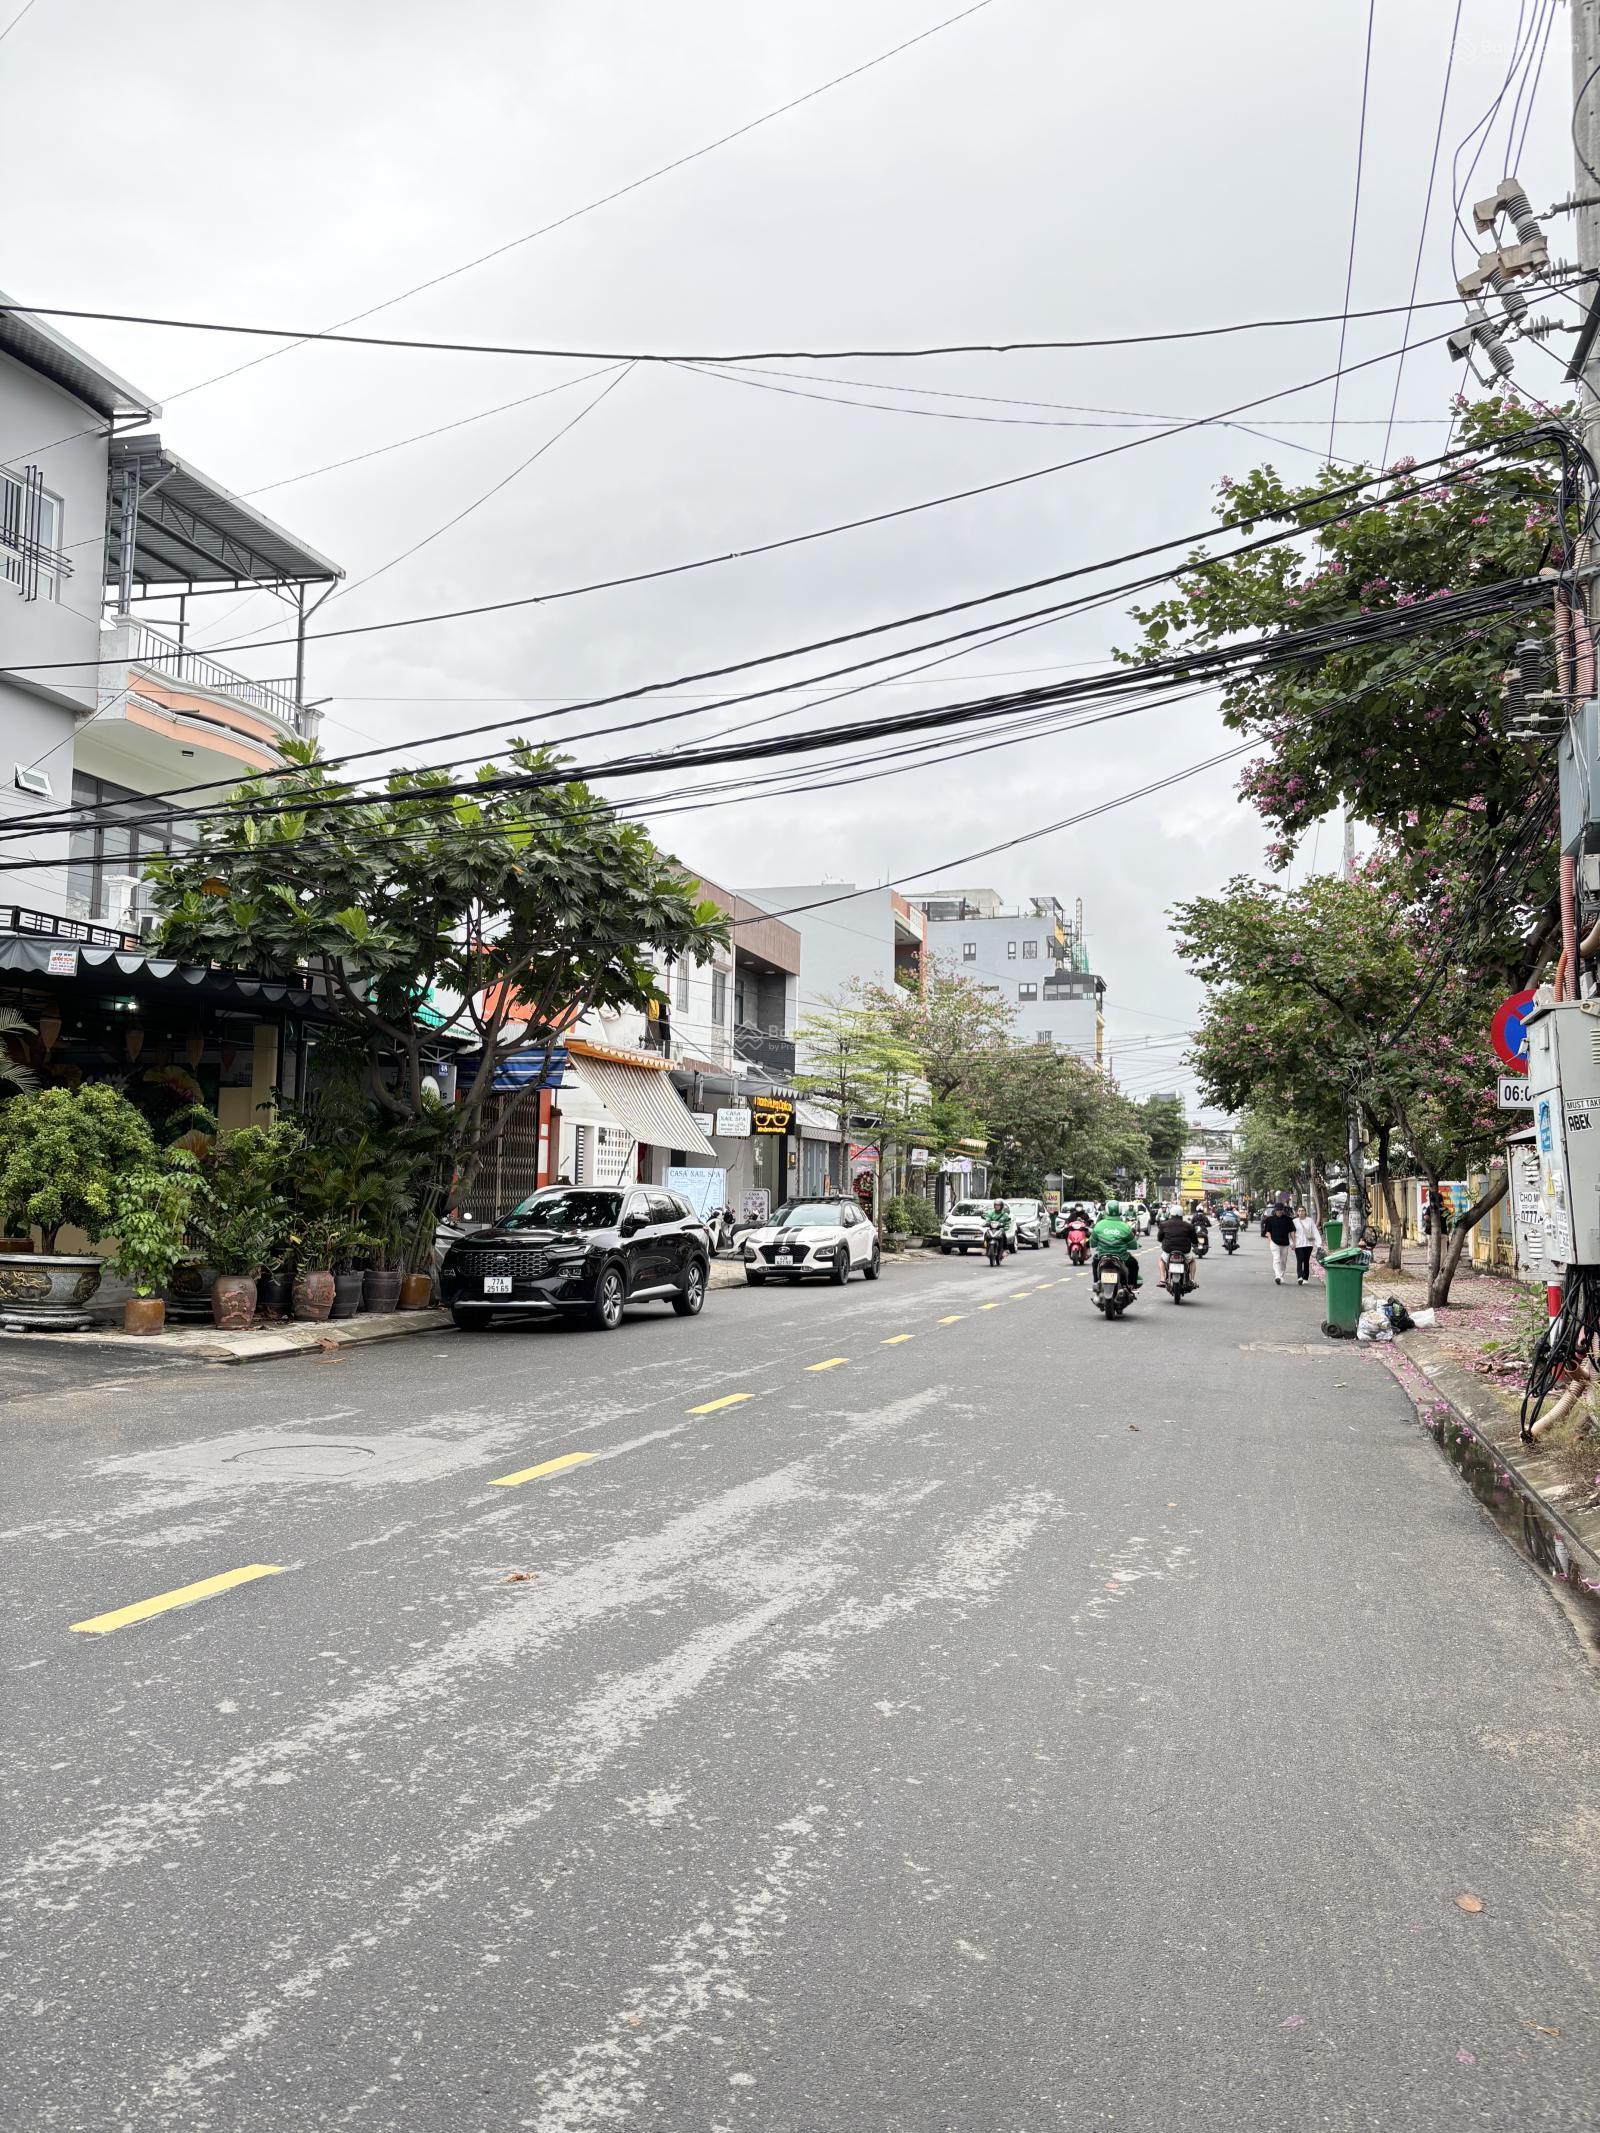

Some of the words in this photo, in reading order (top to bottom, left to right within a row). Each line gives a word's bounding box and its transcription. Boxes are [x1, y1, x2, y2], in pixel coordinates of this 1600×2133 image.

[1567, 1101, 1584, 1109] MUST
[670, 1170, 688, 1178] CASA
[691, 1170, 705, 1178] NAIL
[1520, 1194, 1532, 1202] CHO
[1103, 1228, 1120, 1236] Grab
